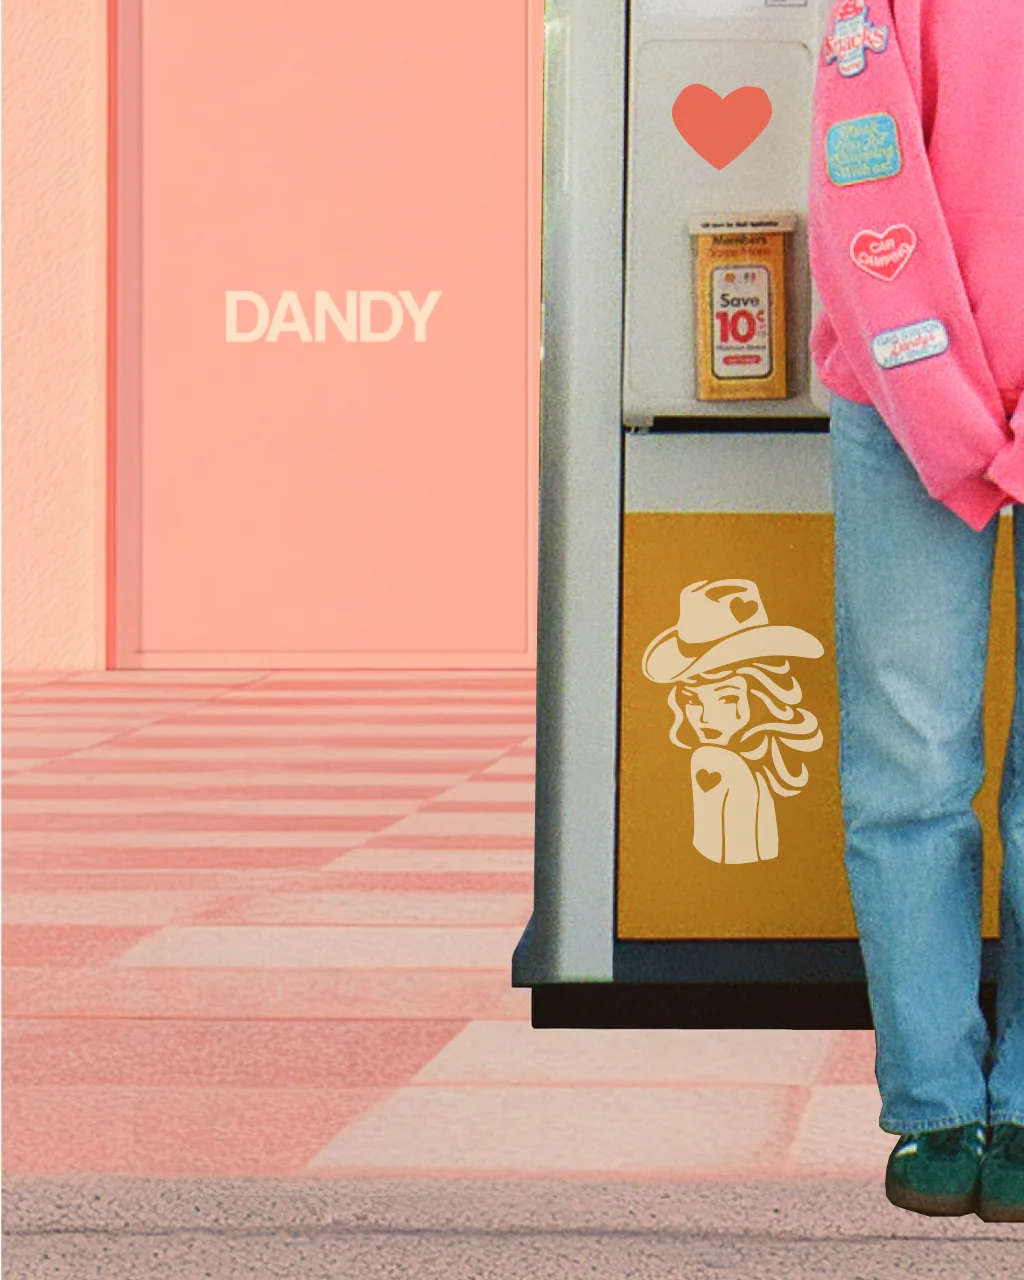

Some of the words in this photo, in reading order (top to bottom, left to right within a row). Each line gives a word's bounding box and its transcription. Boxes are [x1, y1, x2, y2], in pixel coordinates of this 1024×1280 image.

[869, 238, 896, 253] CAR
[720, 293, 760, 308] Save
[225, 290, 443, 342] DANDY
